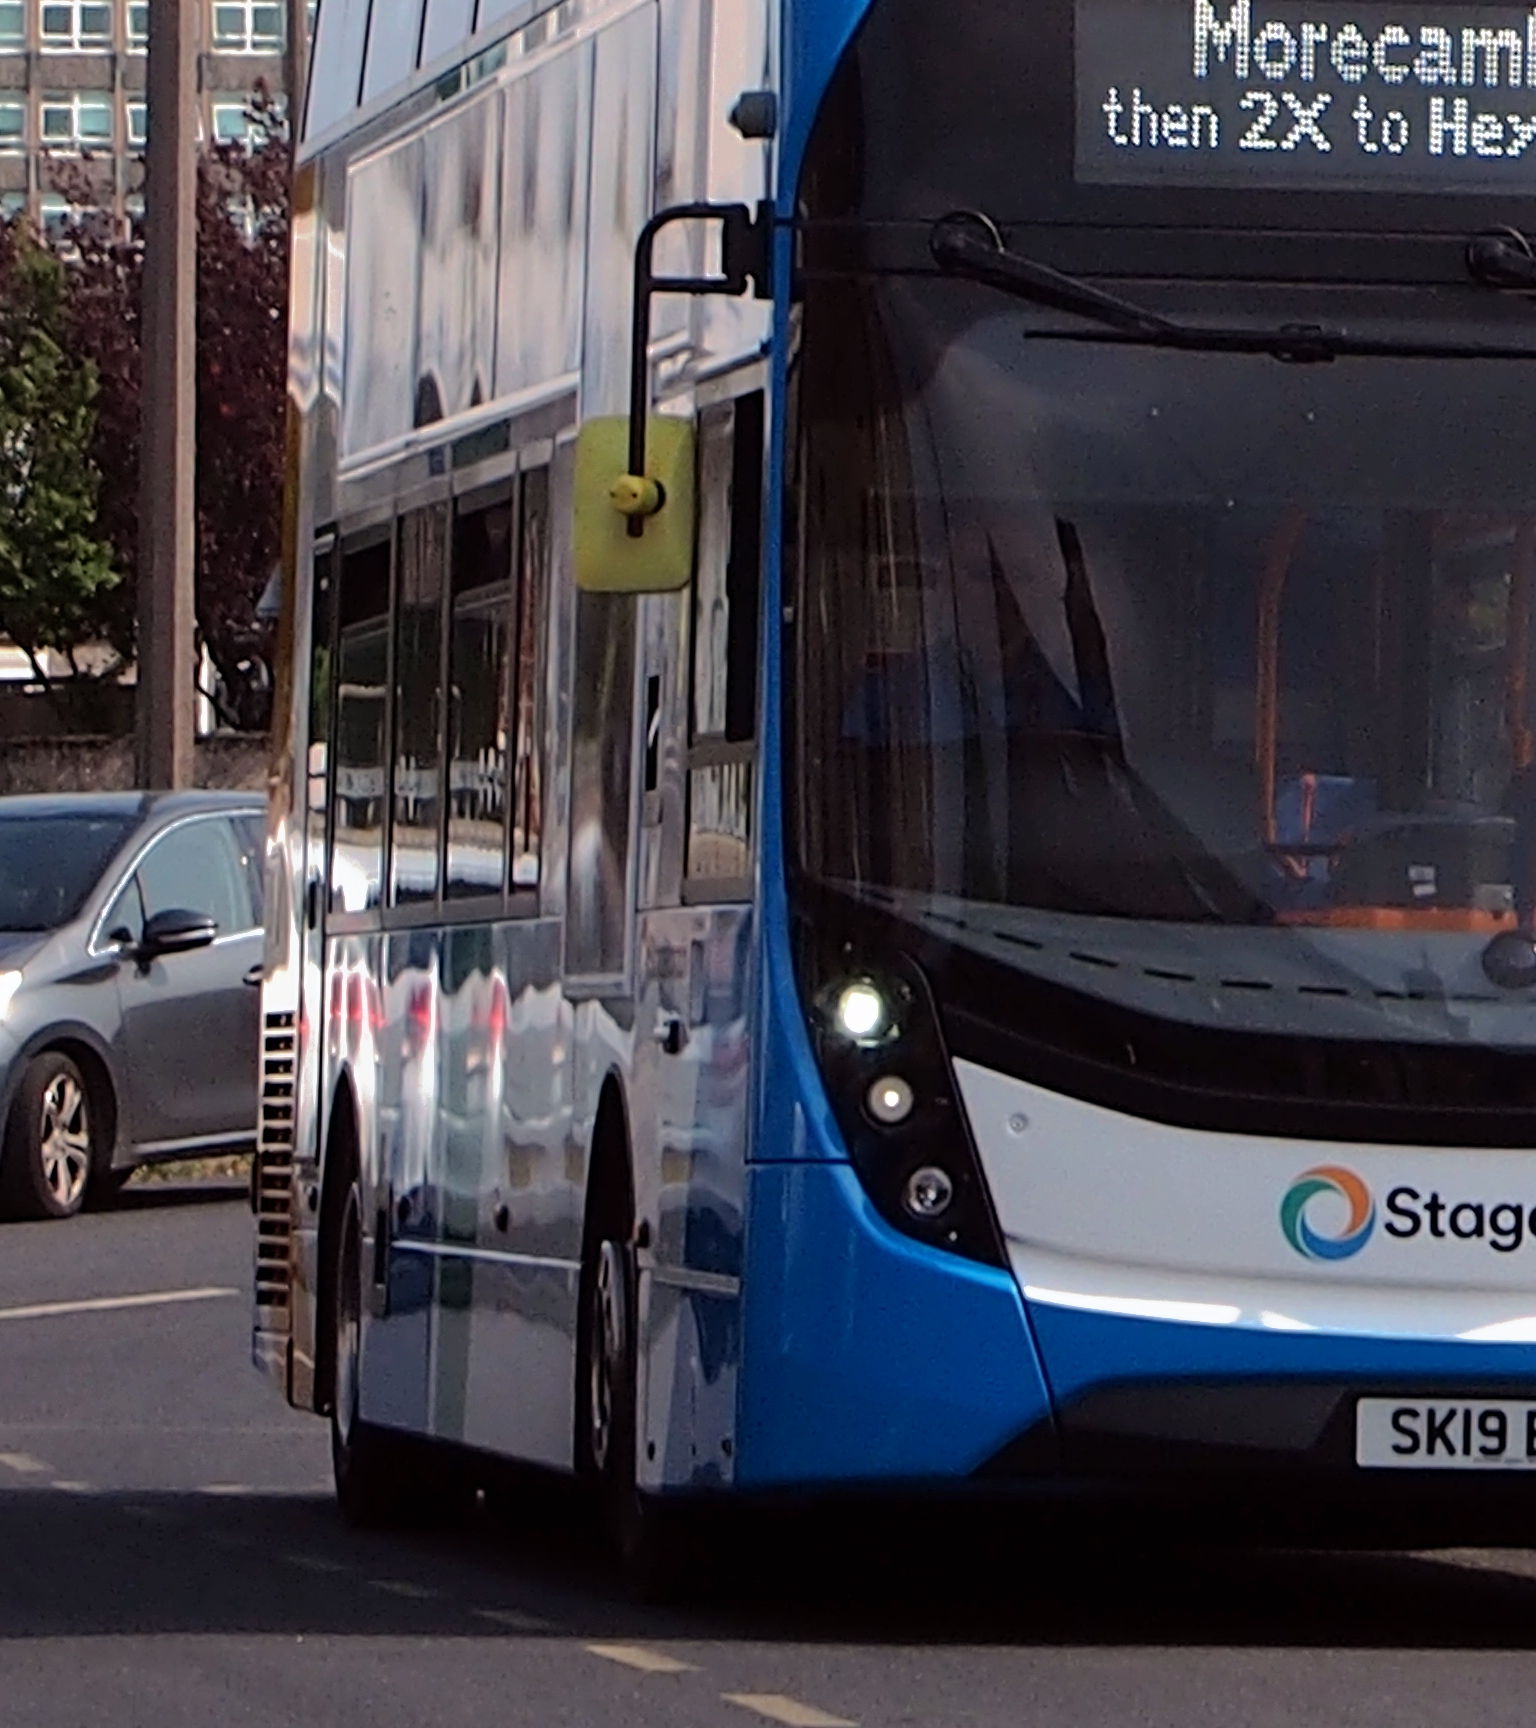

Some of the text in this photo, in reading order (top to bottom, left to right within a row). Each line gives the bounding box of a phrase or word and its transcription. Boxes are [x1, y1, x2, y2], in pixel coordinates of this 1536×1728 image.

[1102, 86, 1219, 149] then
[1238, 90, 1332, 152] 2X
[1352, 93, 1411, 154] to
[1389, 1407, 1509, 1458] SK19
